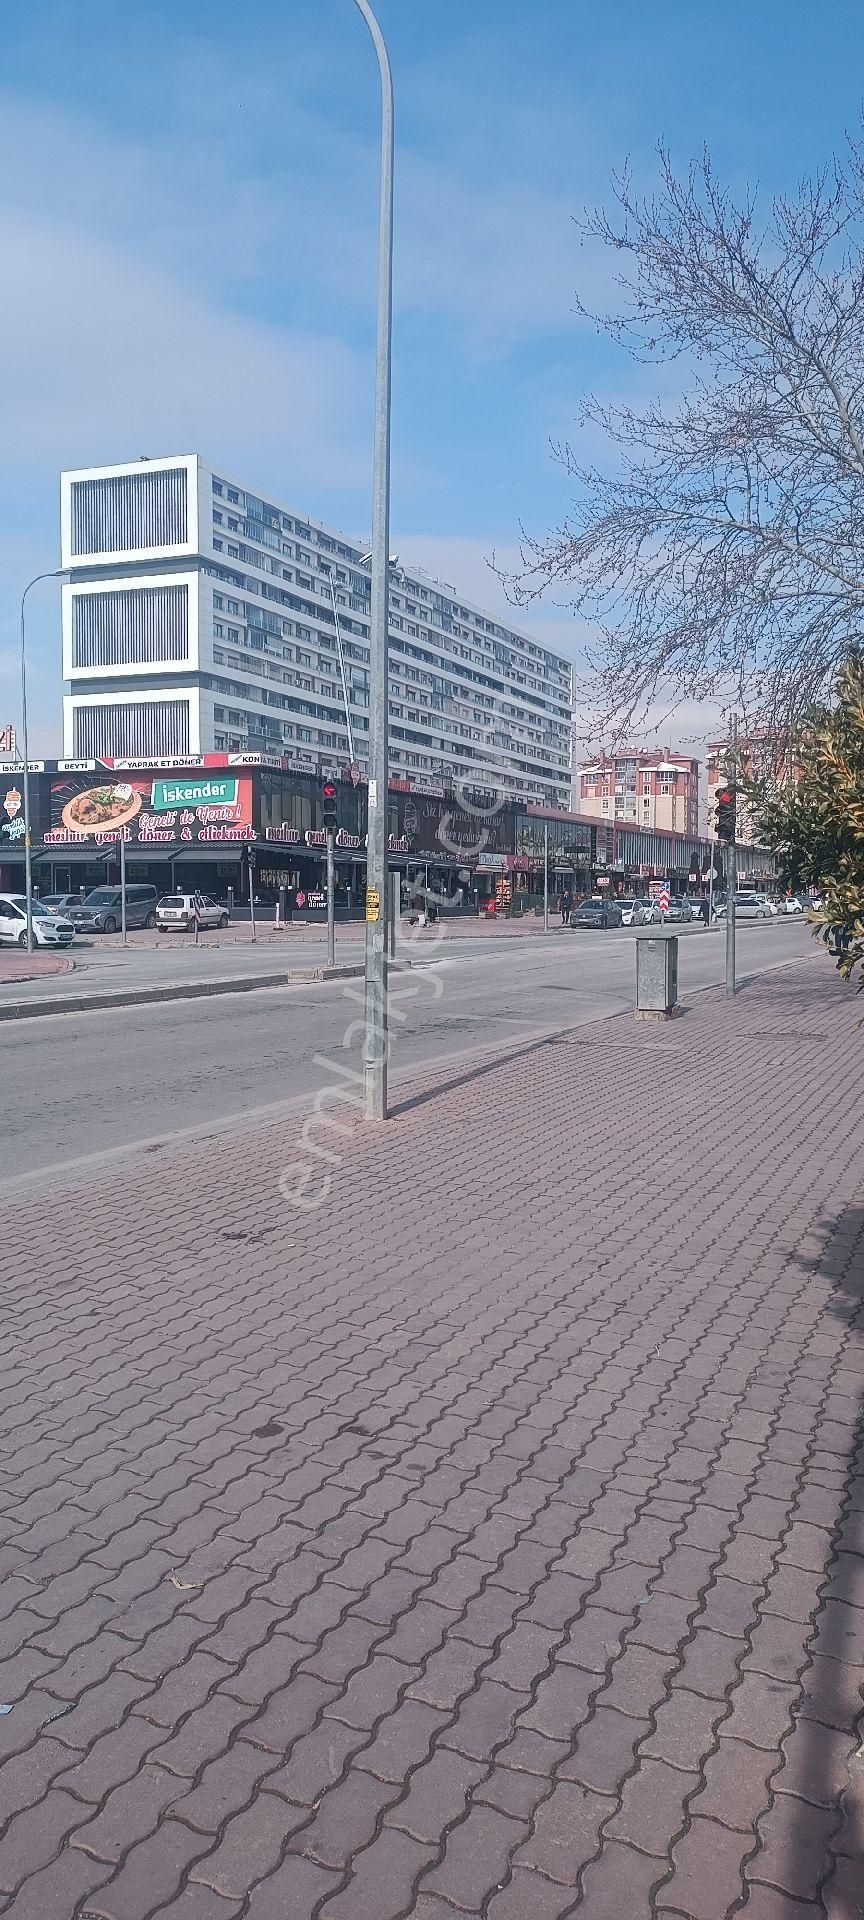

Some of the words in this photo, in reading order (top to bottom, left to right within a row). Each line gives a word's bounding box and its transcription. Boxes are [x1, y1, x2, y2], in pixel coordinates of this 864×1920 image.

[64, 762, 88, 770] BEYTİ
[127, 759, 159, 768] YAPRAK
[173, 757, 202, 766] DÖNER
[162, 783, 227, 803] İskender
[137, 826, 175, 842] döner
[181, 828, 192, 841] &
